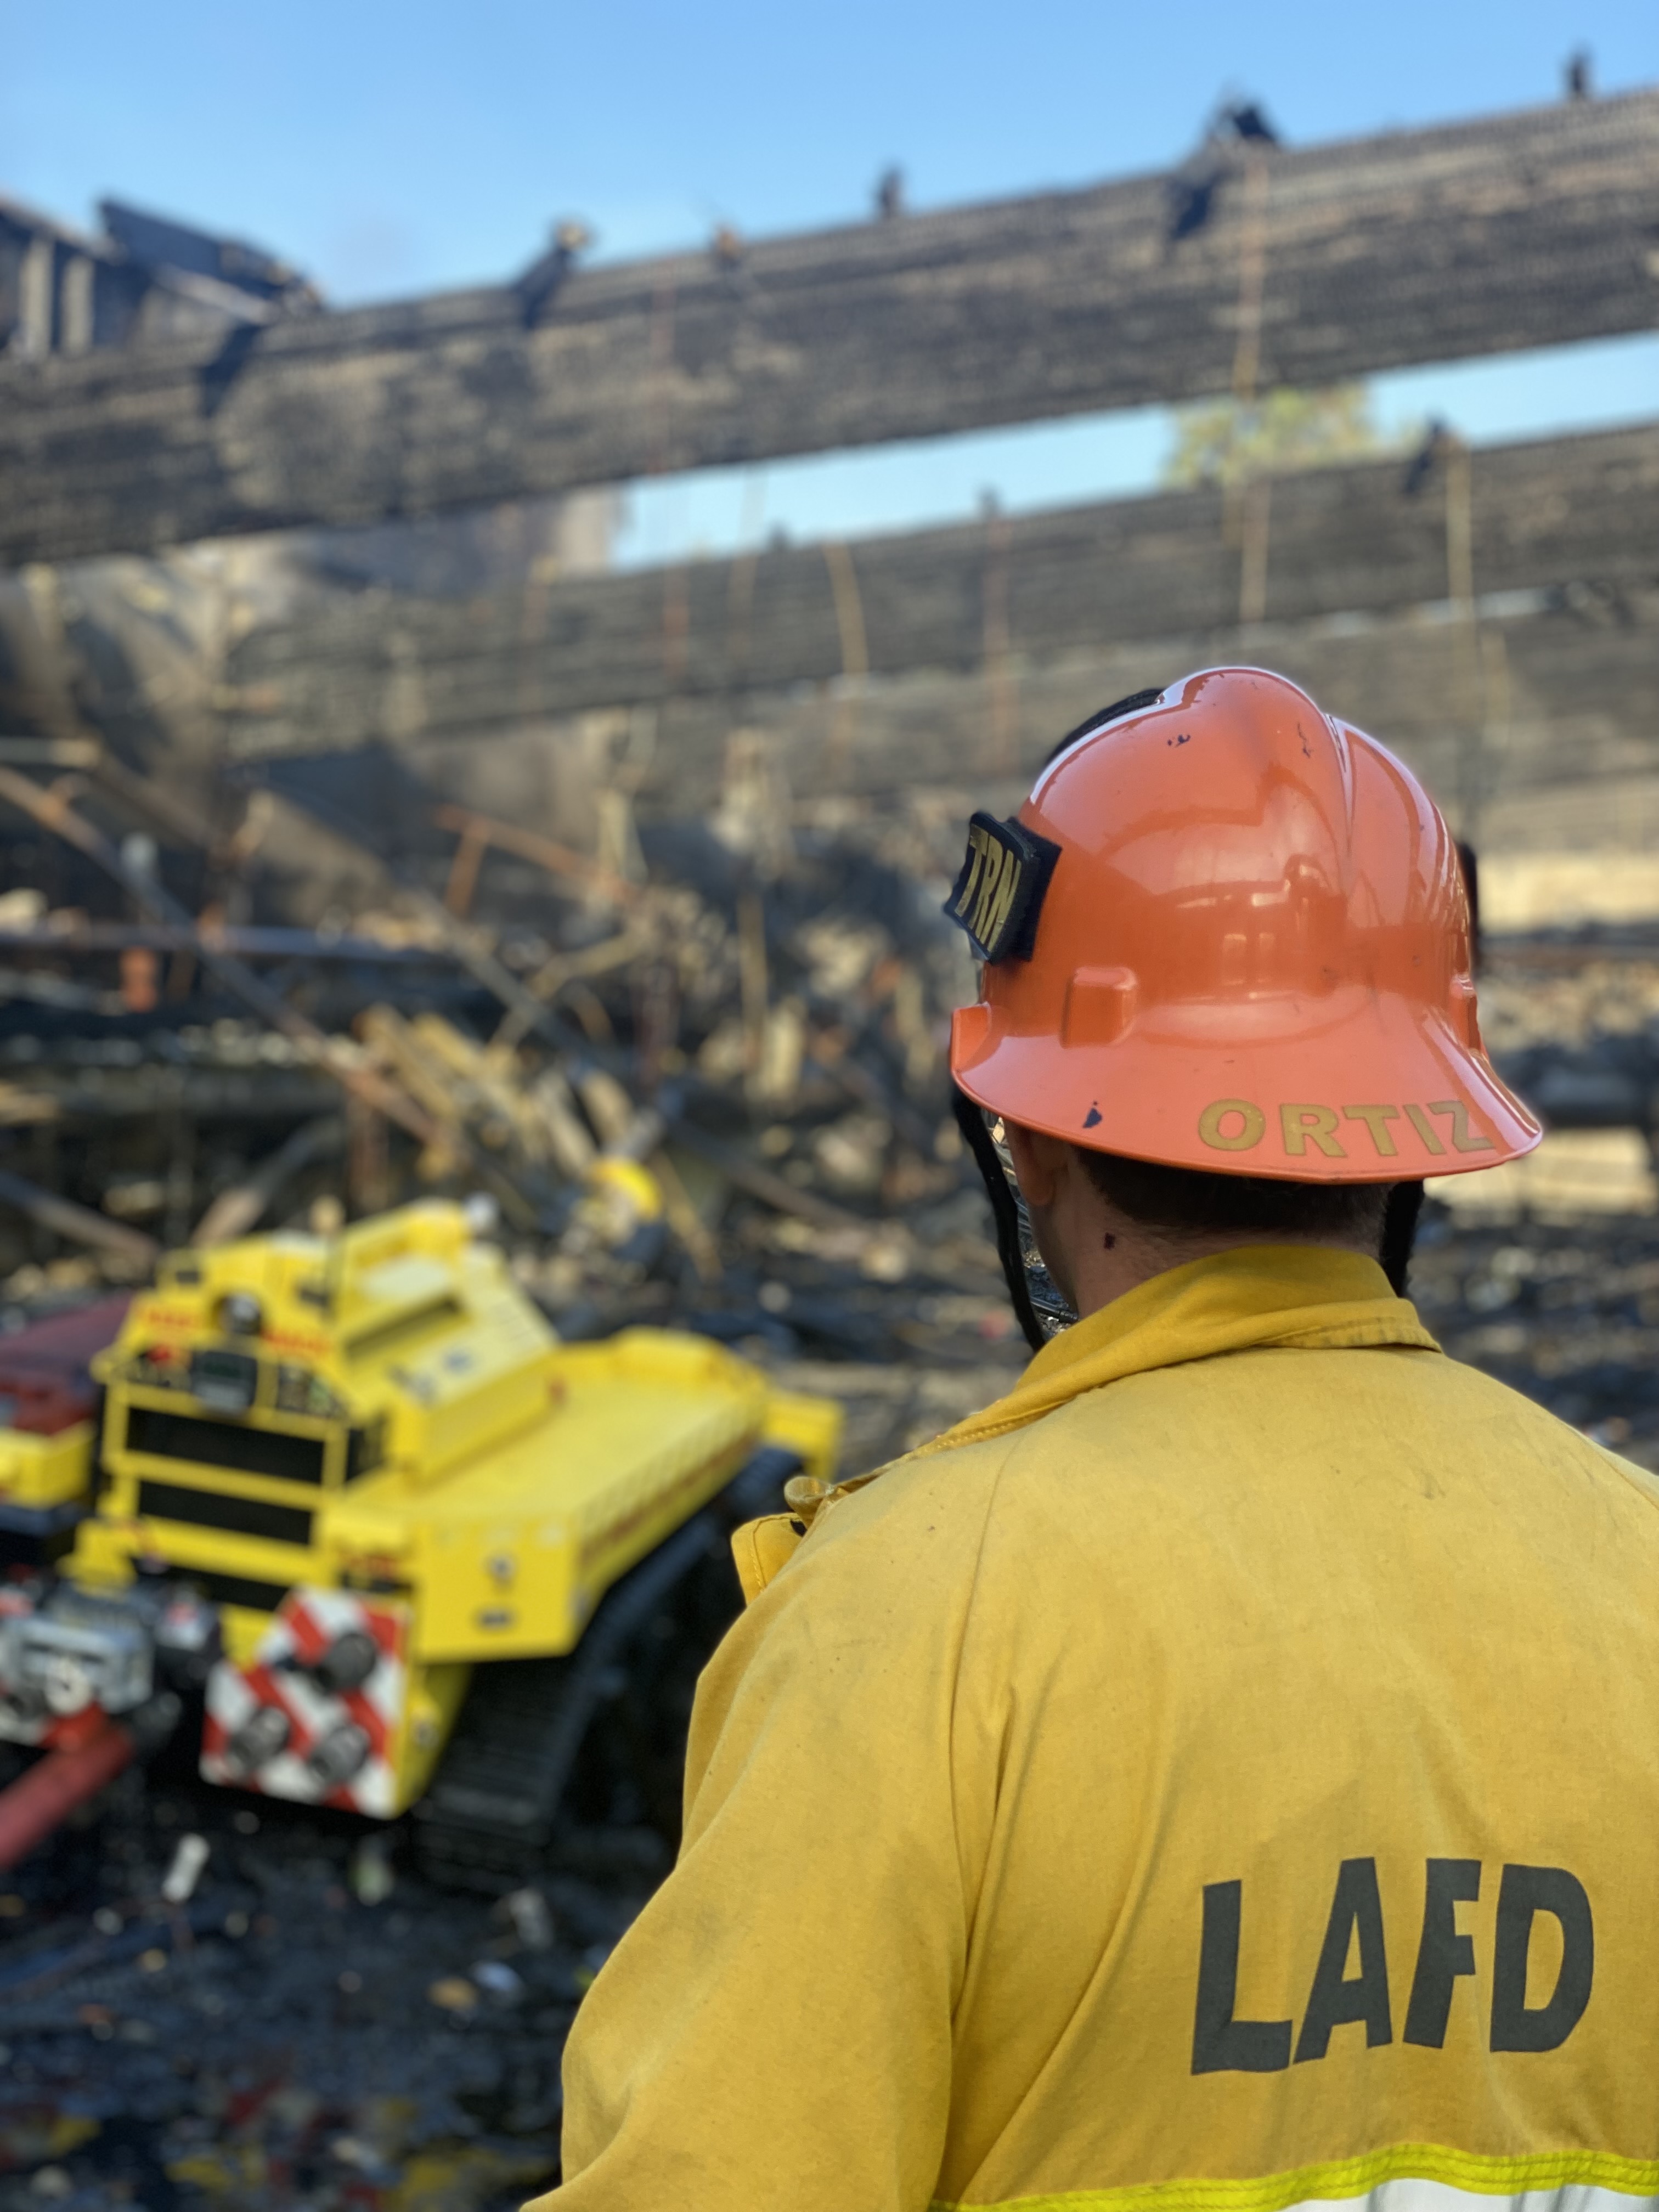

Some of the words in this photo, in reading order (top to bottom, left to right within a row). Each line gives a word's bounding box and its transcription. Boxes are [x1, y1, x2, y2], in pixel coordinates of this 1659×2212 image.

[955, 824, 1022, 952] TRN
[1198, 1098, 1497, 1157] ORTIZ
[1191, 1857, 1594, 2075] LAFD
